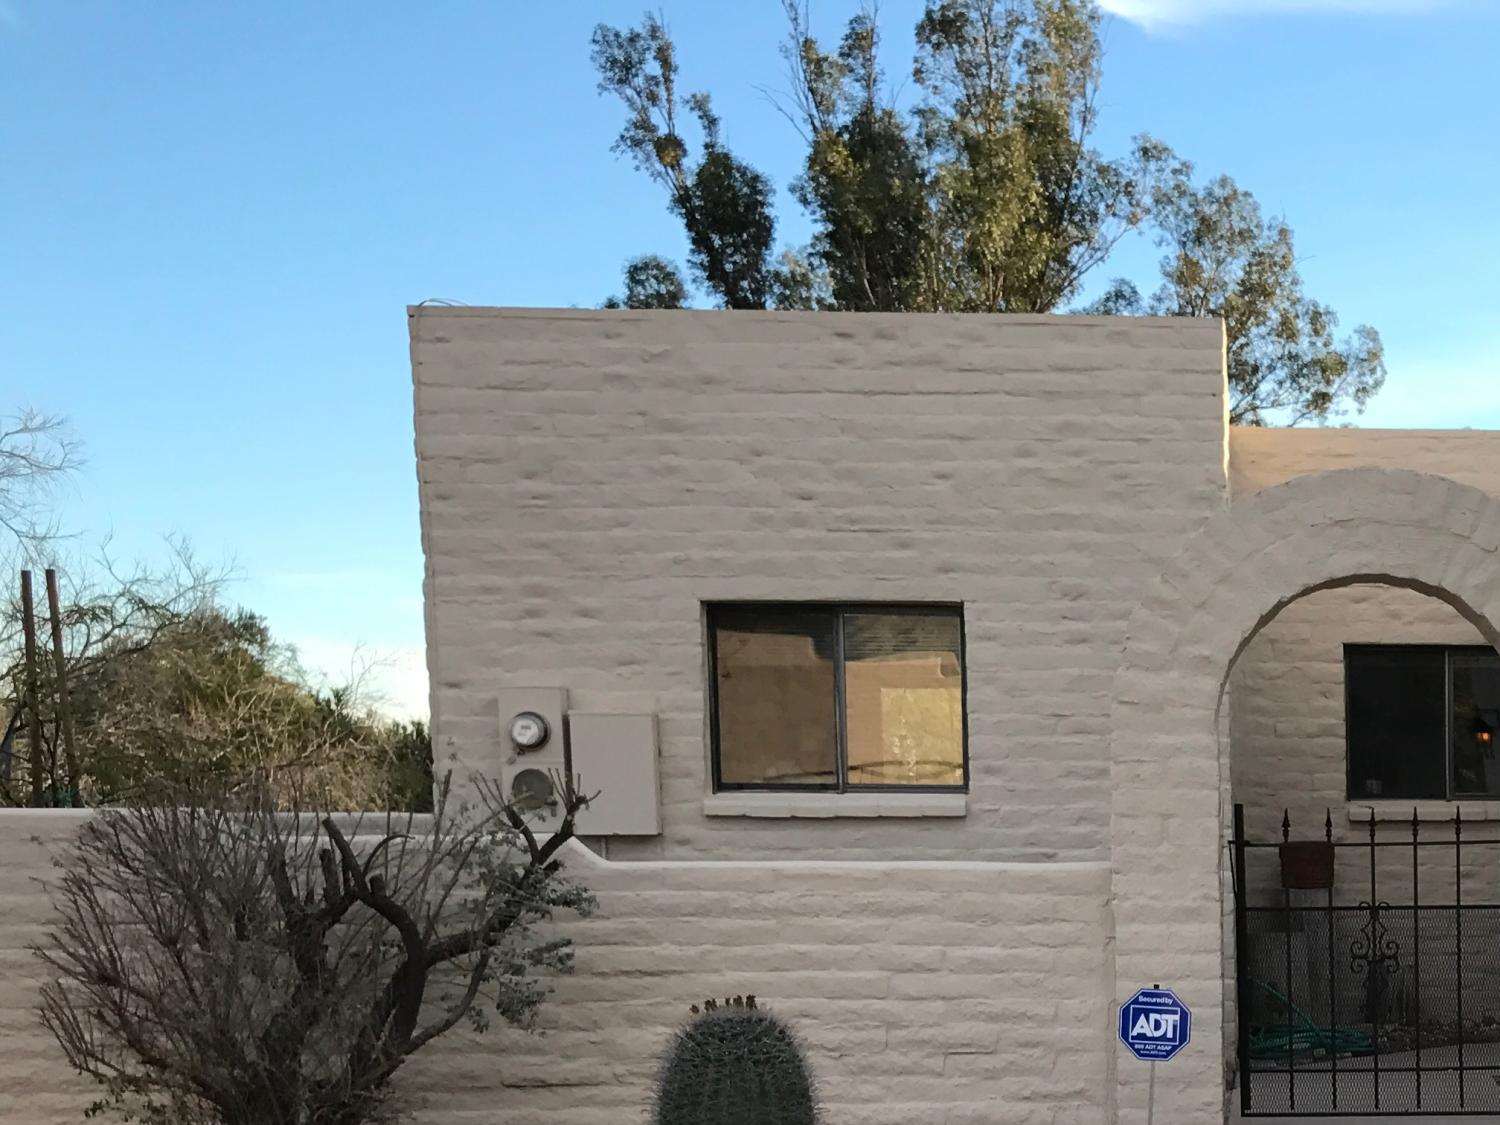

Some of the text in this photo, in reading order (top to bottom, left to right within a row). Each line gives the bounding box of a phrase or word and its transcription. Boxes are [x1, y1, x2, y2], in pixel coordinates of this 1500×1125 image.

[1138, 995, 1173, 1005] Secured by
[1131, 1013, 1179, 1038] ADT
